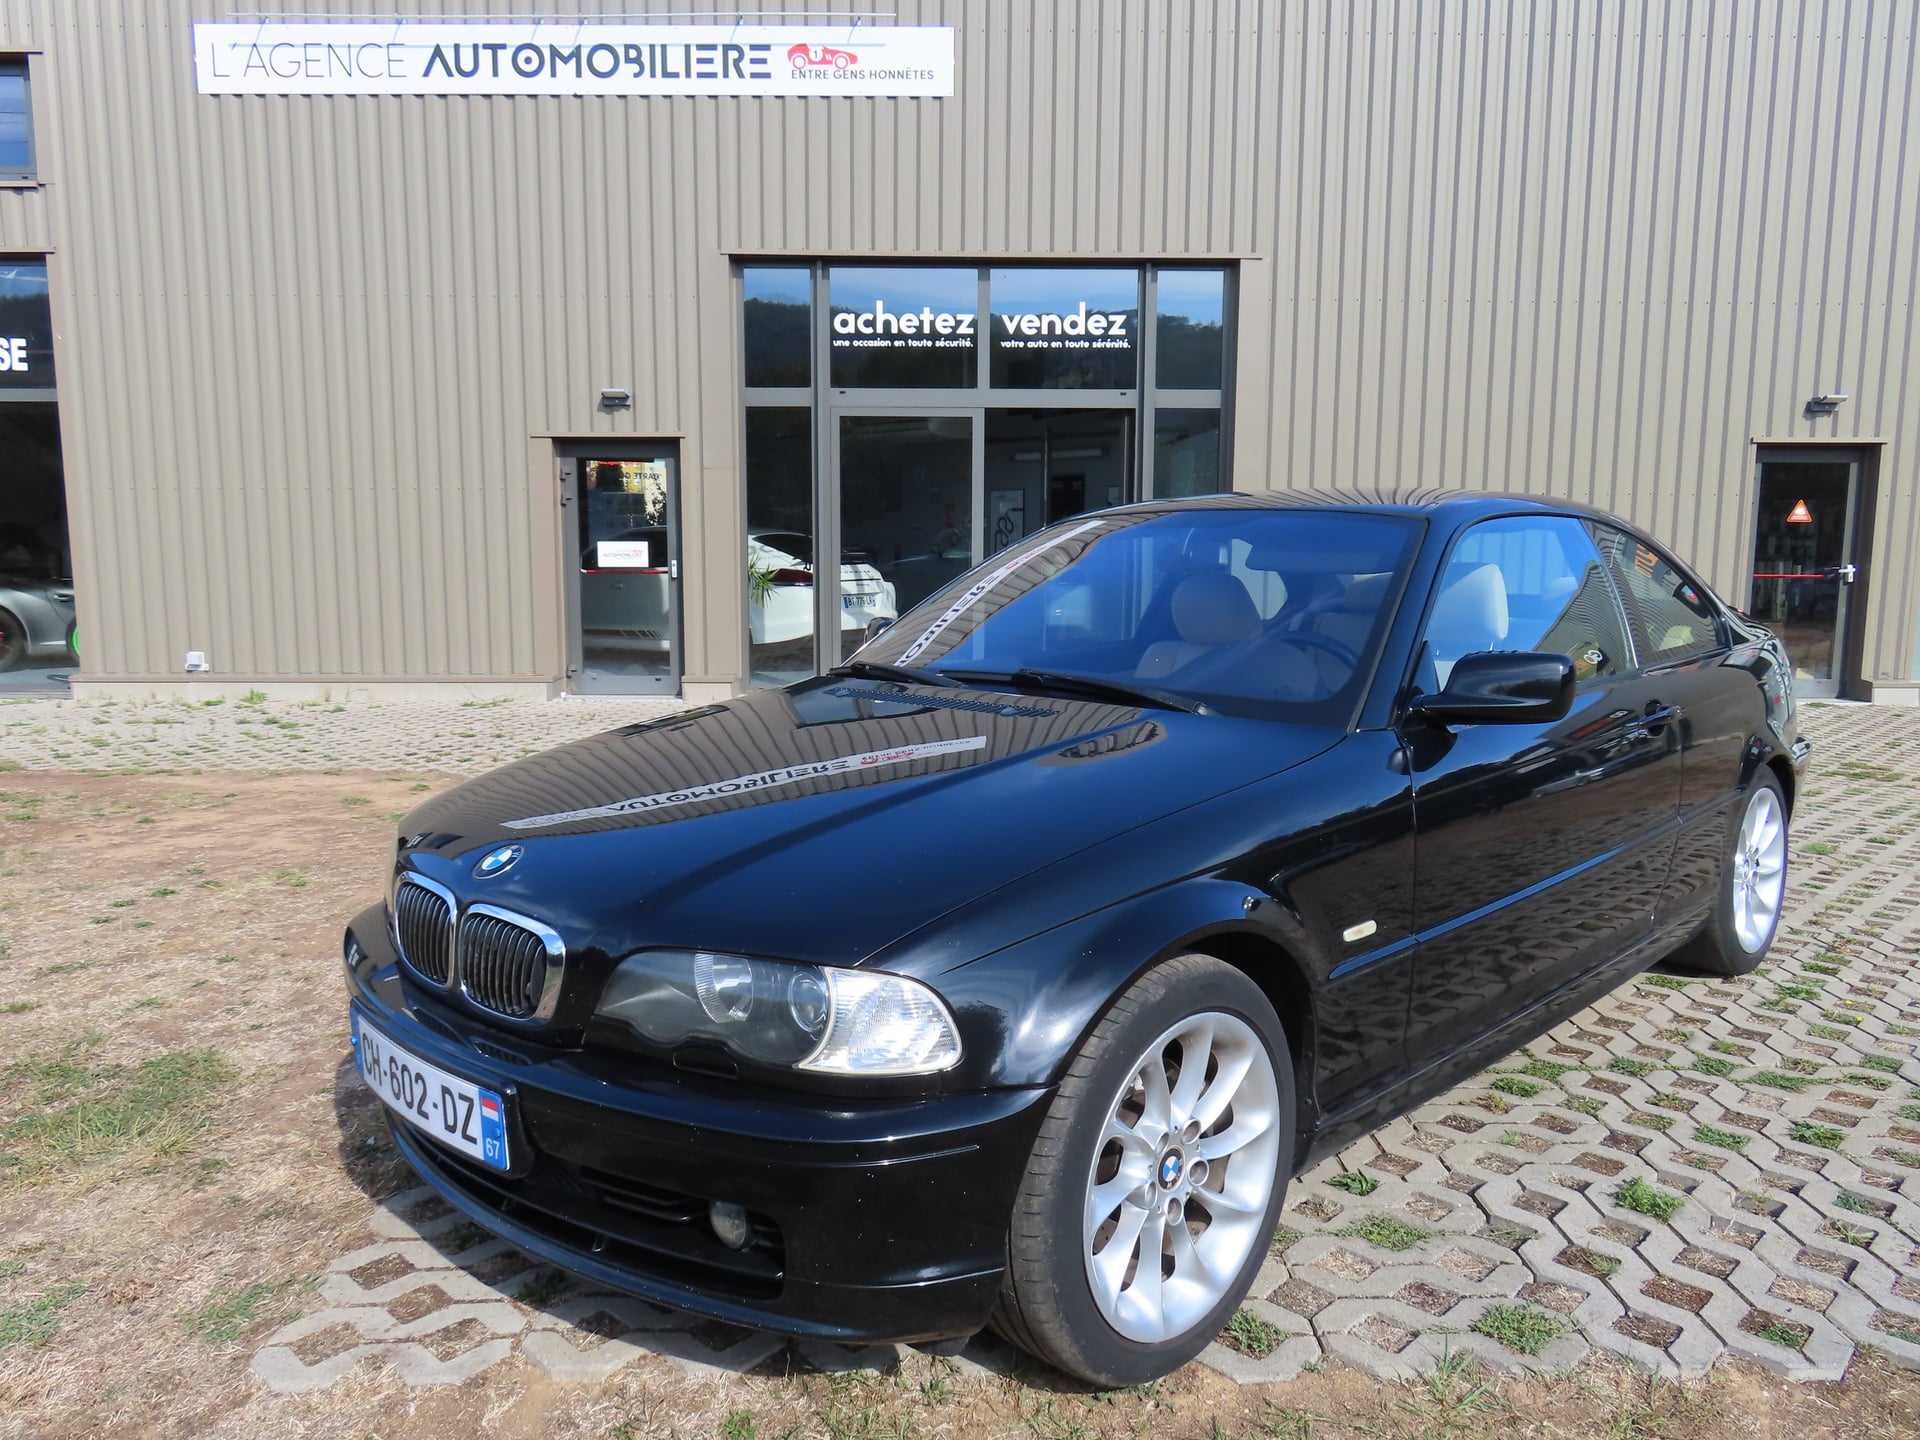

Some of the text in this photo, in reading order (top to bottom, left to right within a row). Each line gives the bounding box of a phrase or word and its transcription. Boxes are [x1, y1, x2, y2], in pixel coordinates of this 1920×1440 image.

[211, 42, 772, 79] L'AGENCE AUTOMOBILIERE
[791, 66, 934, 80] ENTRE GENS HONNÊTES
[833, 300, 975, 335] achetez
[1001, 301, 1127, 336] vendez
[852, 338, 892, 347] occasion
[893, 339, 905, 347] en
[908, 338, 932, 347] toute
[935, 337, 974, 348] sécurité.
[1000, 338, 1131, 348] votre auto en toute sérénité.
[362, 1032, 478, 1146] CH-602-DZ
[485, 1137, 500, 1160] 67
